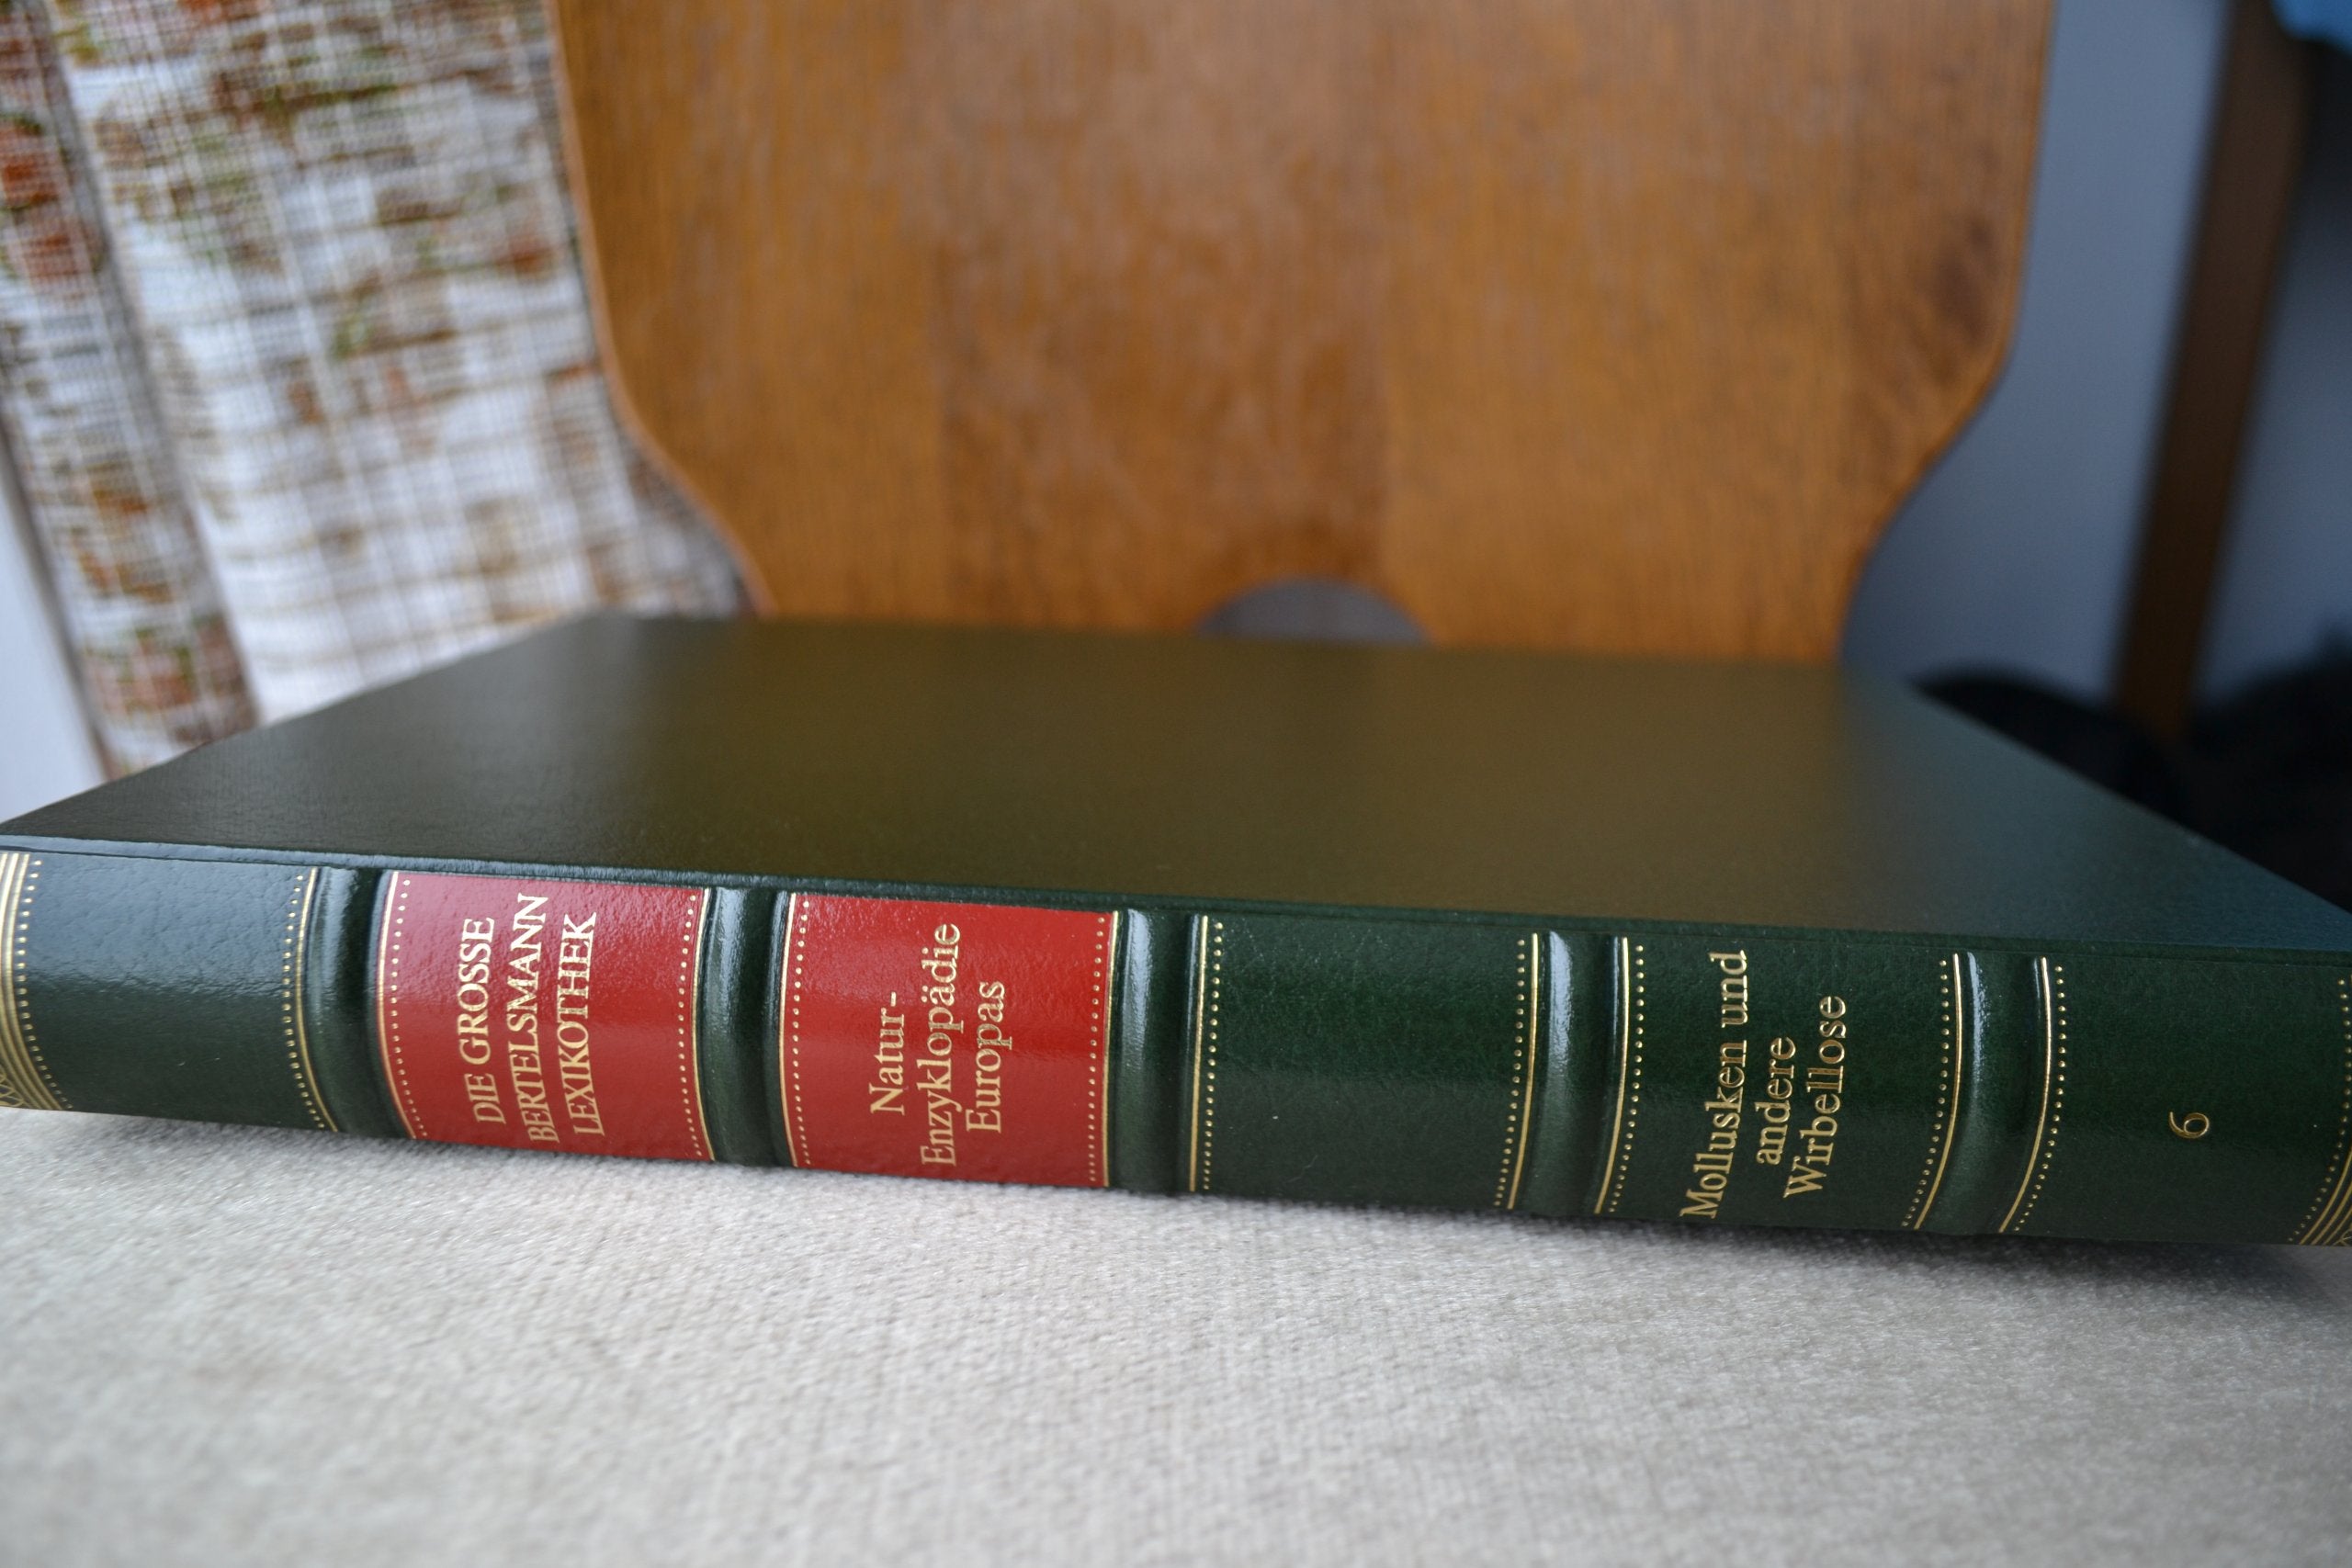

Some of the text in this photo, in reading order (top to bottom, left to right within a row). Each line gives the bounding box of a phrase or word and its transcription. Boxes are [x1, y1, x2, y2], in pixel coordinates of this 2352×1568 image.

[457, 917, 506, 1124] DIE GROSSE
[506, 892, 560, 1144] BERTELSMANN
[556, 911, 605, 1136] LEXIKOTHEK
[868, 991, 905, 1116] Natur-
[916, 923, 964, 1167] Enzyklopädie
[966, 981, 1012, 1134] Europas
[1679, 950, 1748, 1220] Mollusken und
[1755, 1036, 1796, 1165] andere
[1782, 996, 1847, 1199] Wirbellose
[2169, 1111, 2210, 1139] 6
